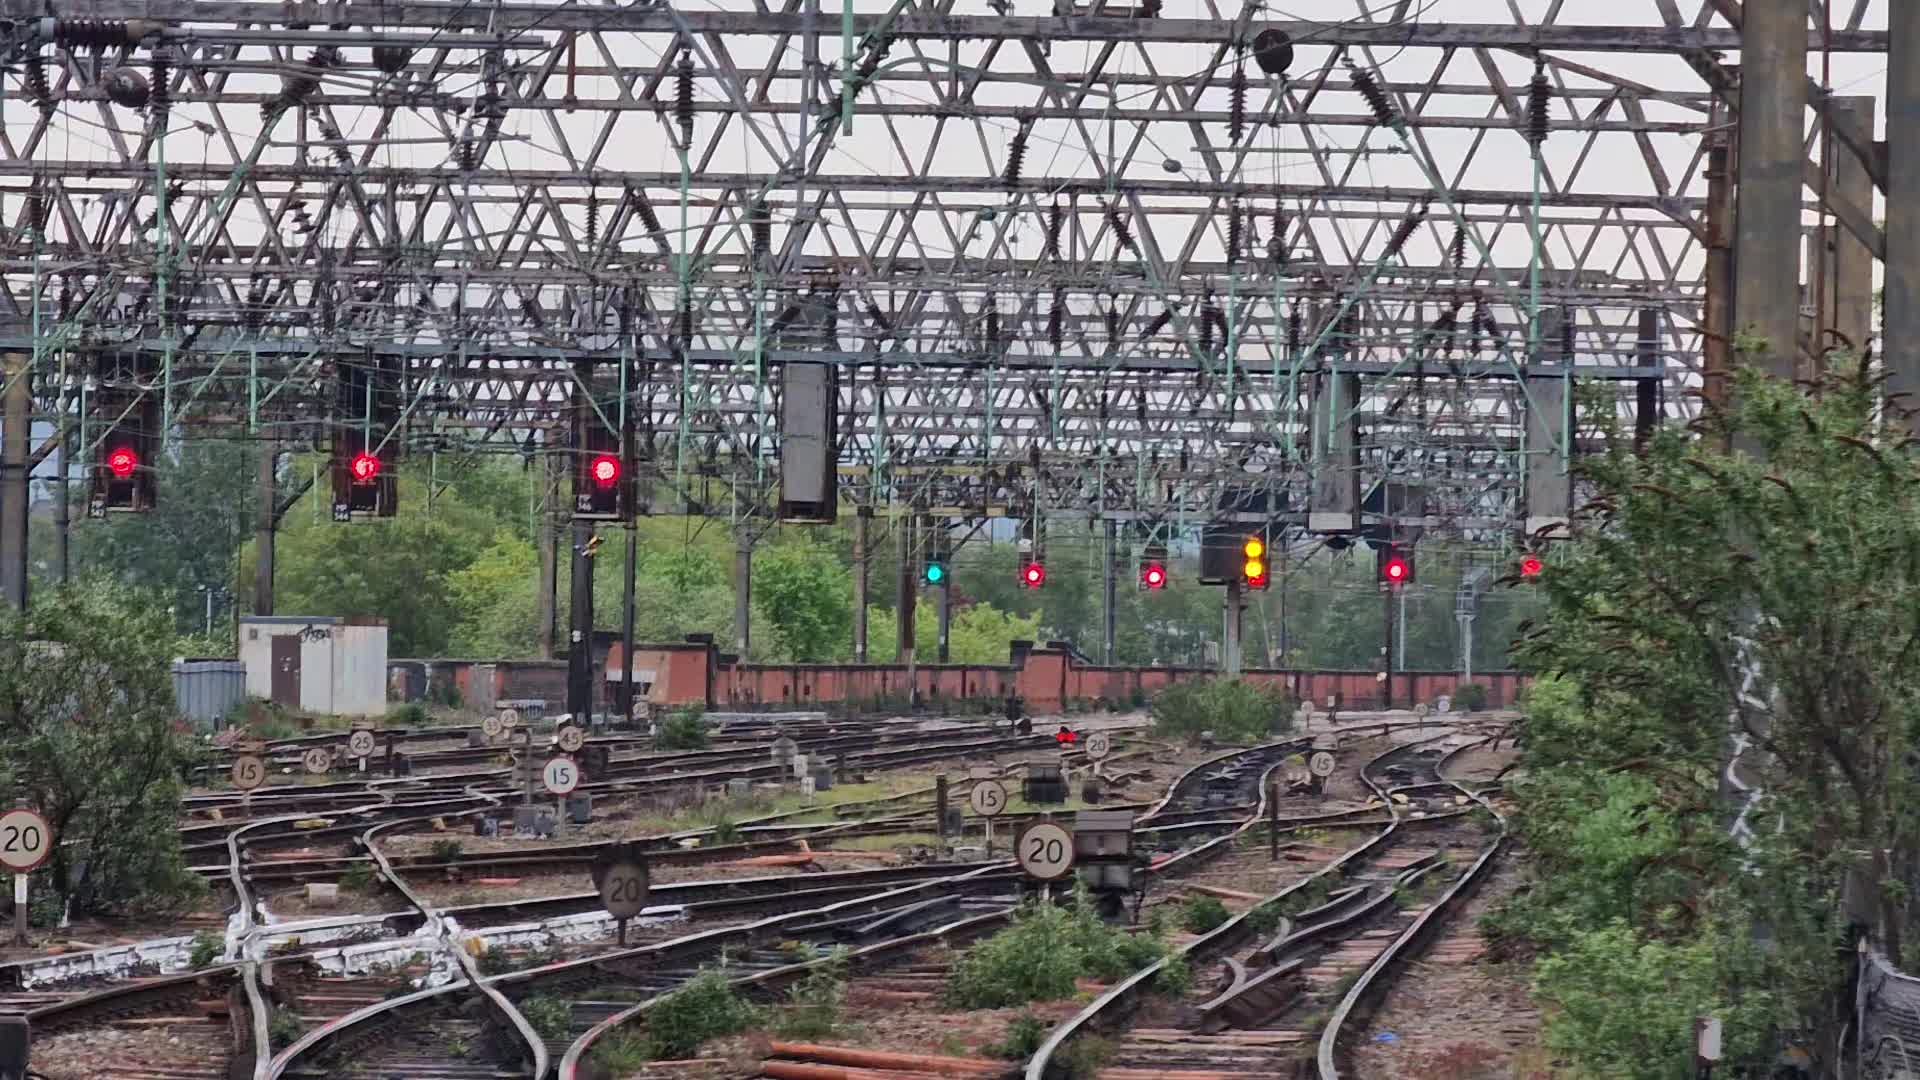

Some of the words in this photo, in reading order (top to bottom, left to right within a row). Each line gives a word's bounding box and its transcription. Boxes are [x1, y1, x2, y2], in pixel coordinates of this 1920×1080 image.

[355, 738, 369, 750] 25
[561, 731, 579, 744] 45
[1090, 739, 1105, 751] 20
[308, 754, 327, 767] 45
[1315, 758, 1329, 769] 15
[240, 764, 256, 780] 15
[552, 768, 569, 784] 15
[980, 790, 997, 806] 15
[4, 826, 40, 852] 20
[1029, 838, 1062, 864] 20
[611, 877, 639, 903] 20
